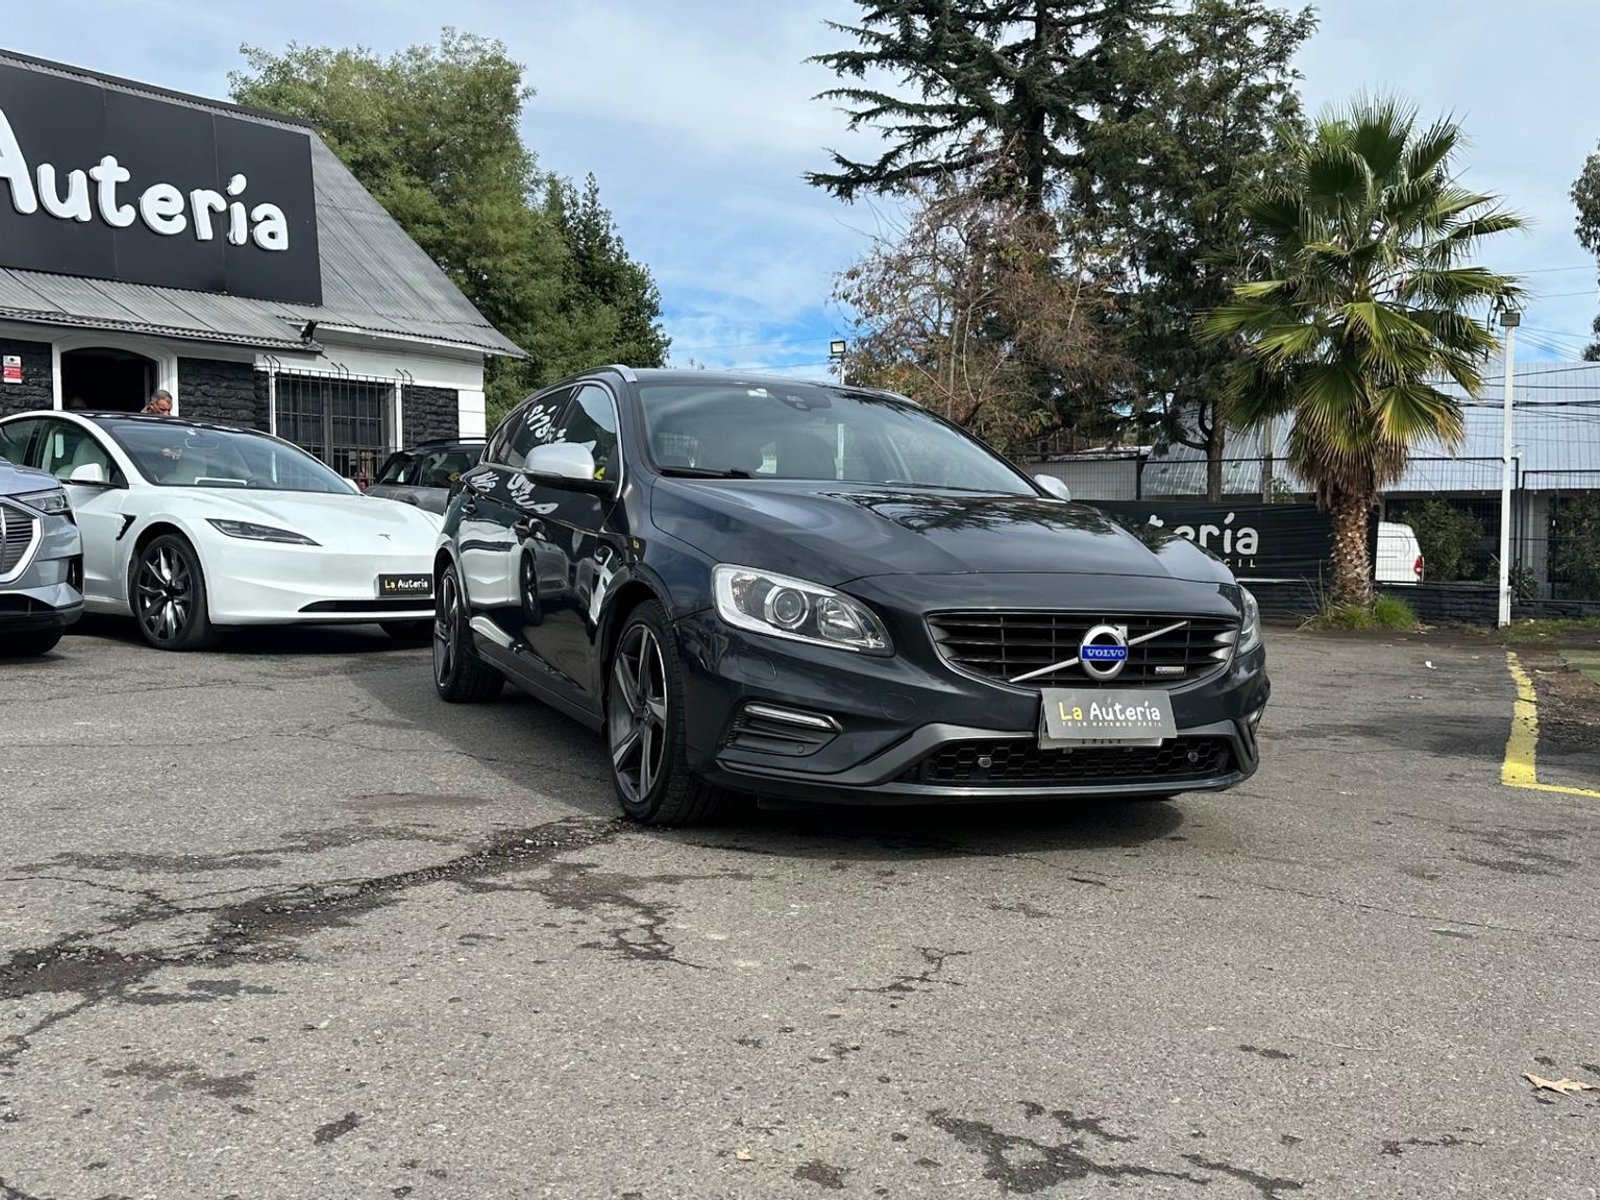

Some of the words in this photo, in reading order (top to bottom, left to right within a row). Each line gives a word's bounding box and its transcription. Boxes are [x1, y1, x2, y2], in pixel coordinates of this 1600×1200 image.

[384, 579, 395, 589] La
[397, 578, 428, 588] Autería
[1086, 648, 1126, 657] VOLVO
[1058, 701, 1083, 721] La
[1089, 700, 1161, 721] Autería
